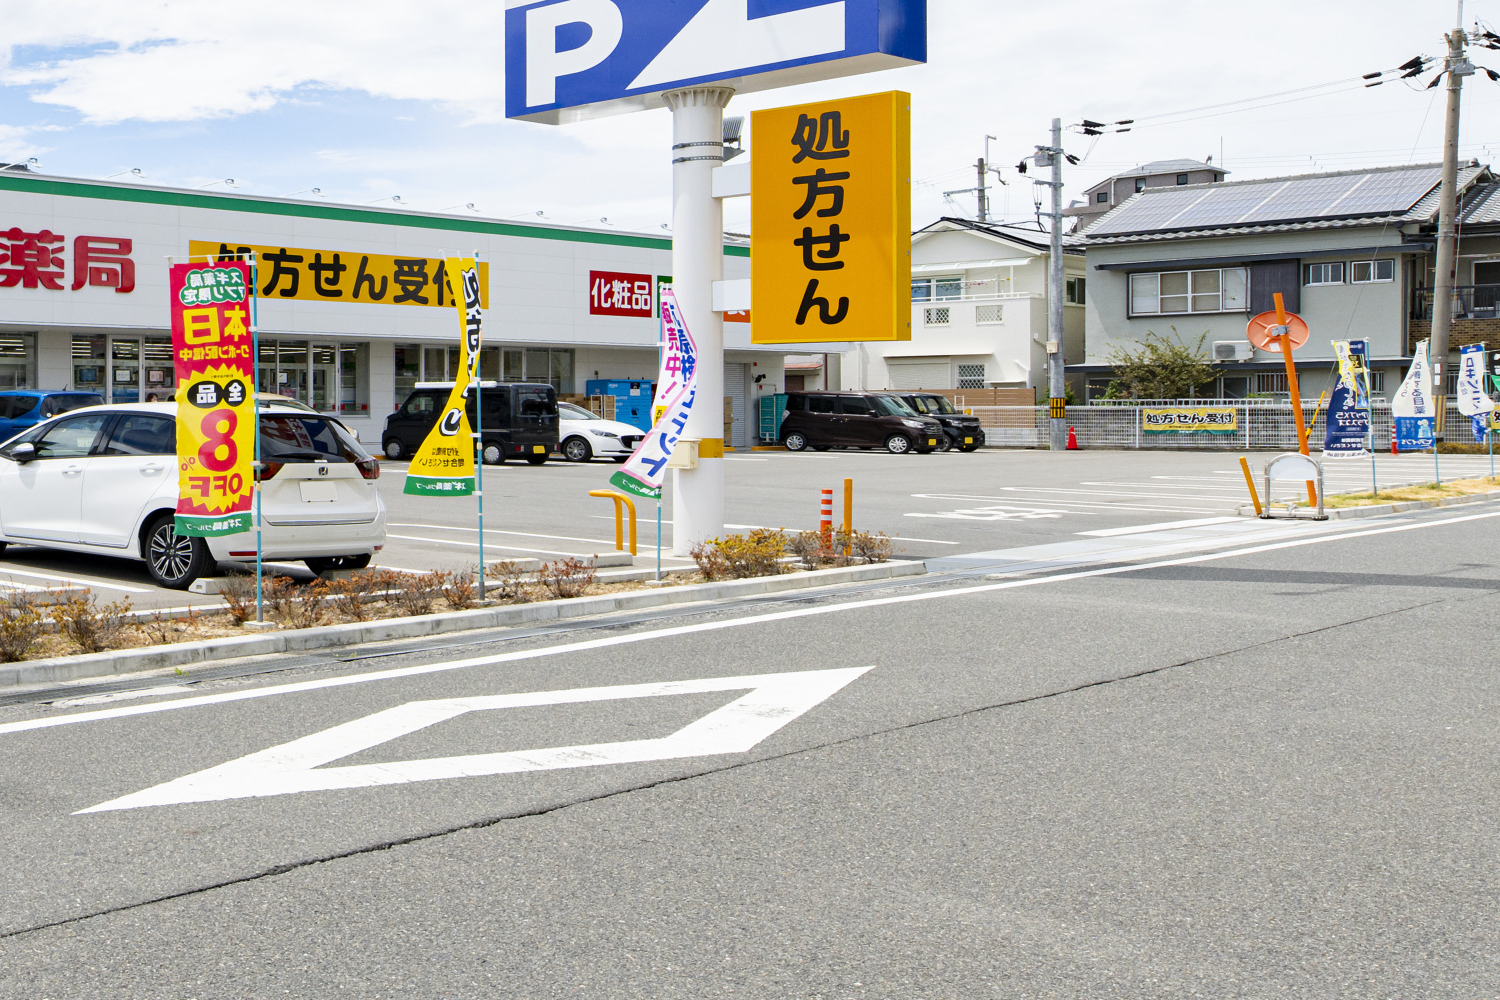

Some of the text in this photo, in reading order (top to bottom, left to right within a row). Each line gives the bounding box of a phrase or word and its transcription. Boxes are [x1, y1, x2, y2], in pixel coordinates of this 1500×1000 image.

[790, 110, 851, 326] 処方せん
[591, 277, 651, 311] 化粧品
[1145, 412, 1235, 425] 処方せん受付
